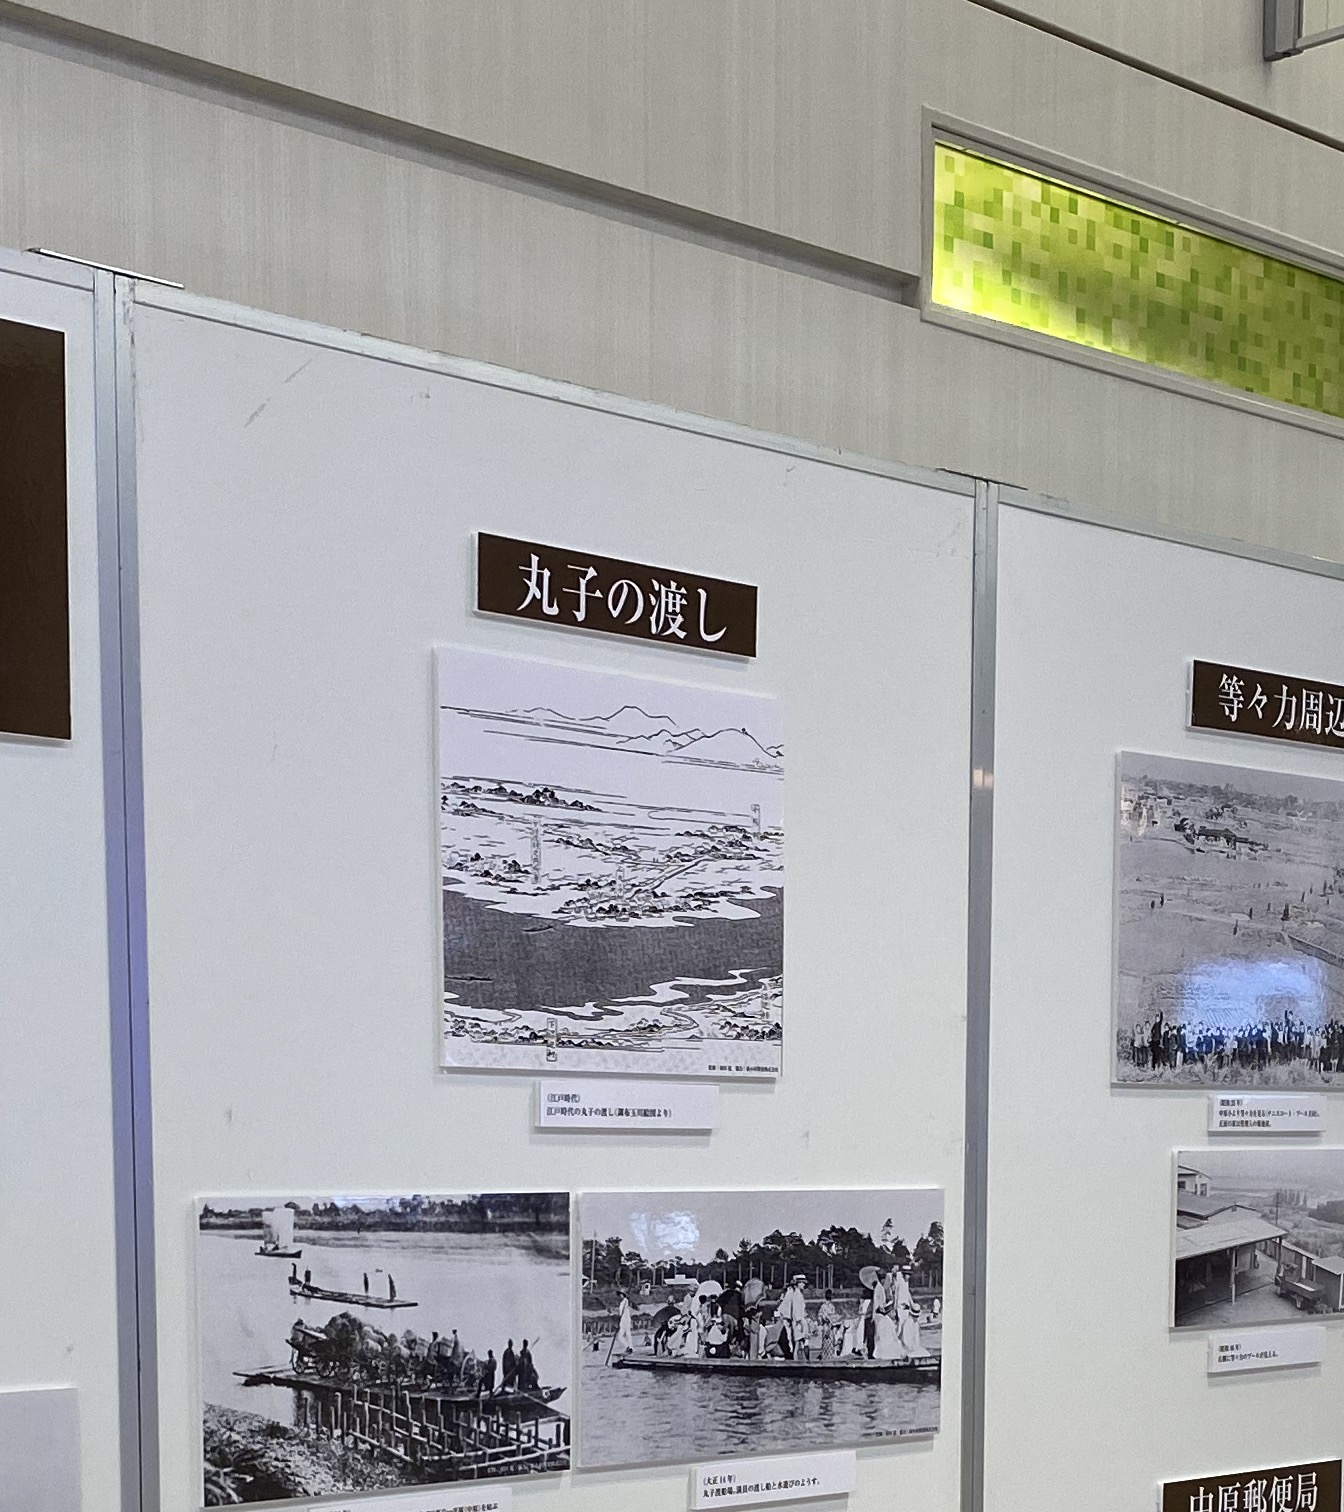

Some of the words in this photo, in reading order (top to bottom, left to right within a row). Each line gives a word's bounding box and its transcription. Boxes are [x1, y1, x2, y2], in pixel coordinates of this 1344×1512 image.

[517, 553, 727, 642] 丸子の渡し
